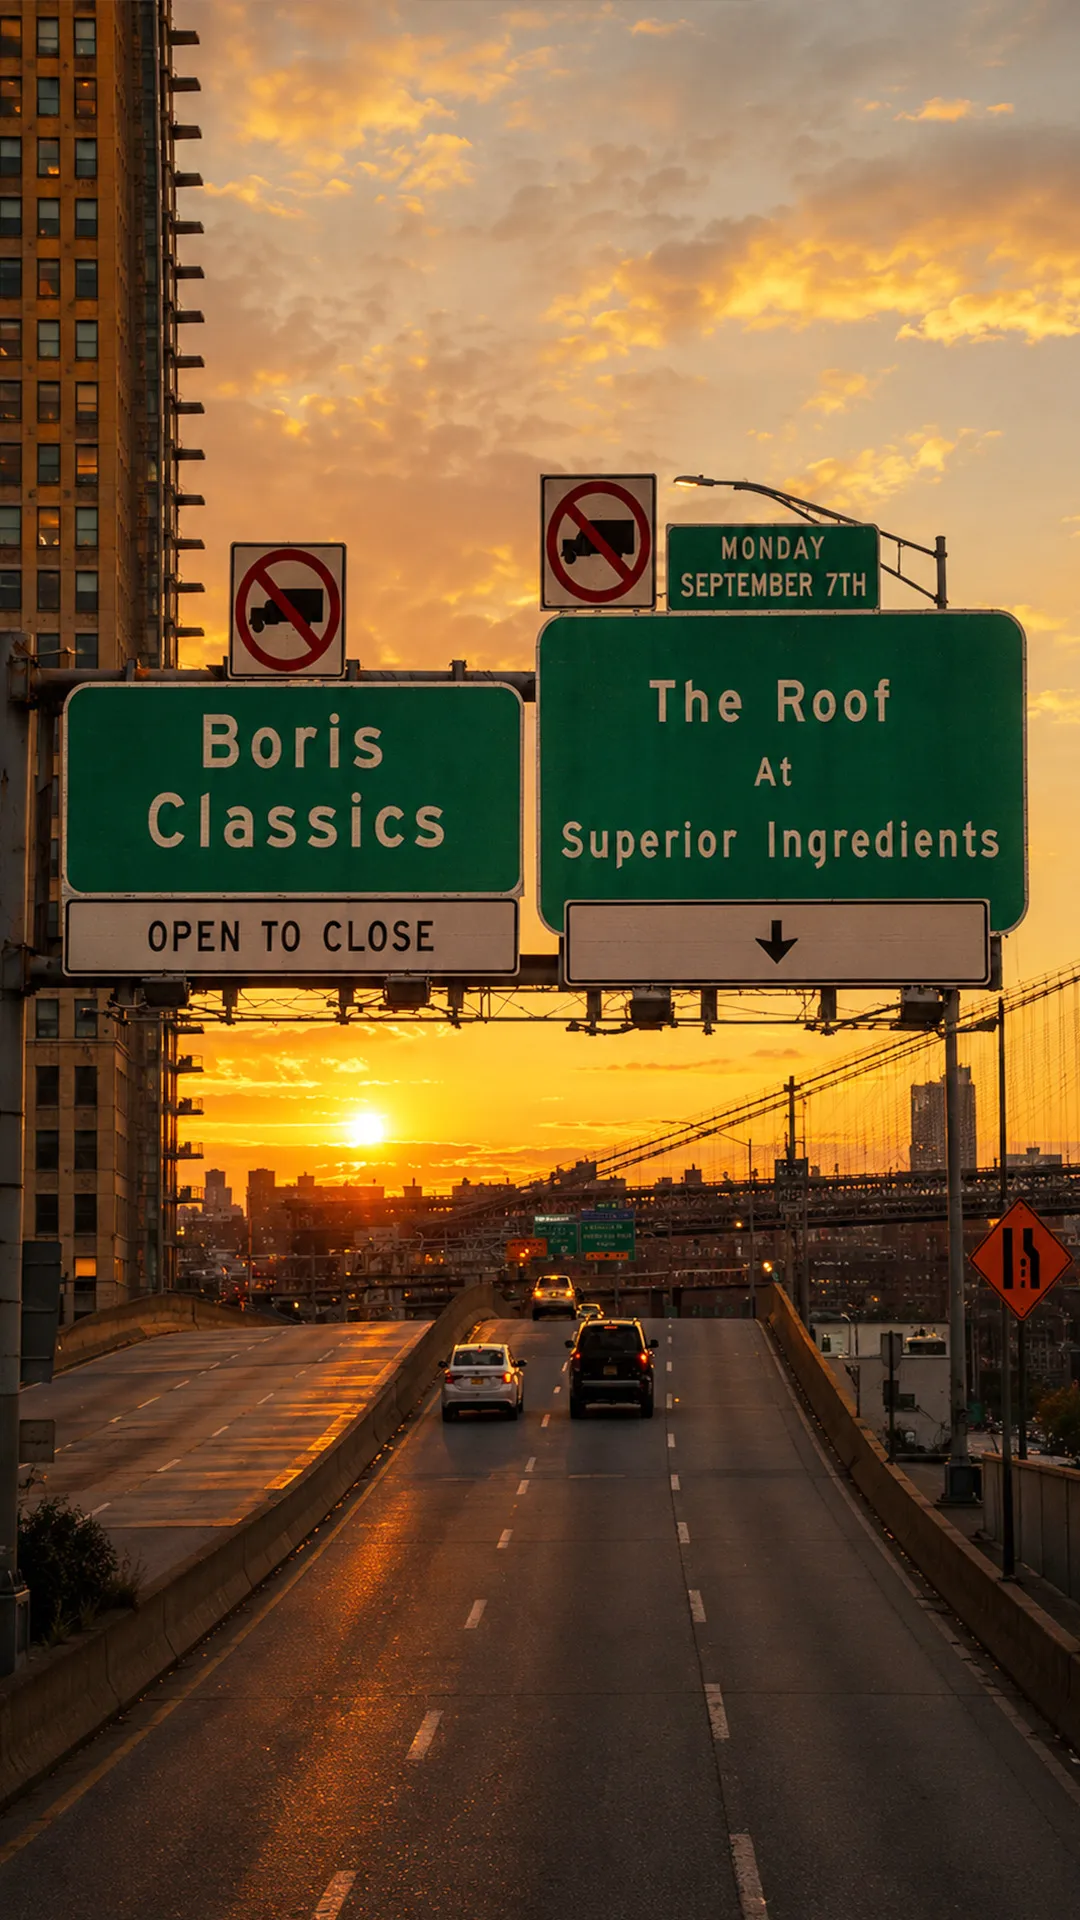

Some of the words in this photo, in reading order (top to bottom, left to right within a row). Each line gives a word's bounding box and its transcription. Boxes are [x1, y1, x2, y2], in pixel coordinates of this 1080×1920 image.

[721, 535, 825, 560] MONDAY
[680, 572, 813, 598] SEPTEMBER
[825, 572, 866, 597] 7TH
[649, 679, 743, 723] The
[777, 678, 890, 723] Roof
[202, 712, 383, 769] Boris
[754, 756, 792, 787] At
[148, 791, 445, 849] Classics
[561, 820, 738, 868] Superior
[768, 820, 1000, 869] Ingredients
[148, 920, 240, 953] OPEN
[262, 920, 301, 953] TO
[323, 919, 435, 952] CLOSE
